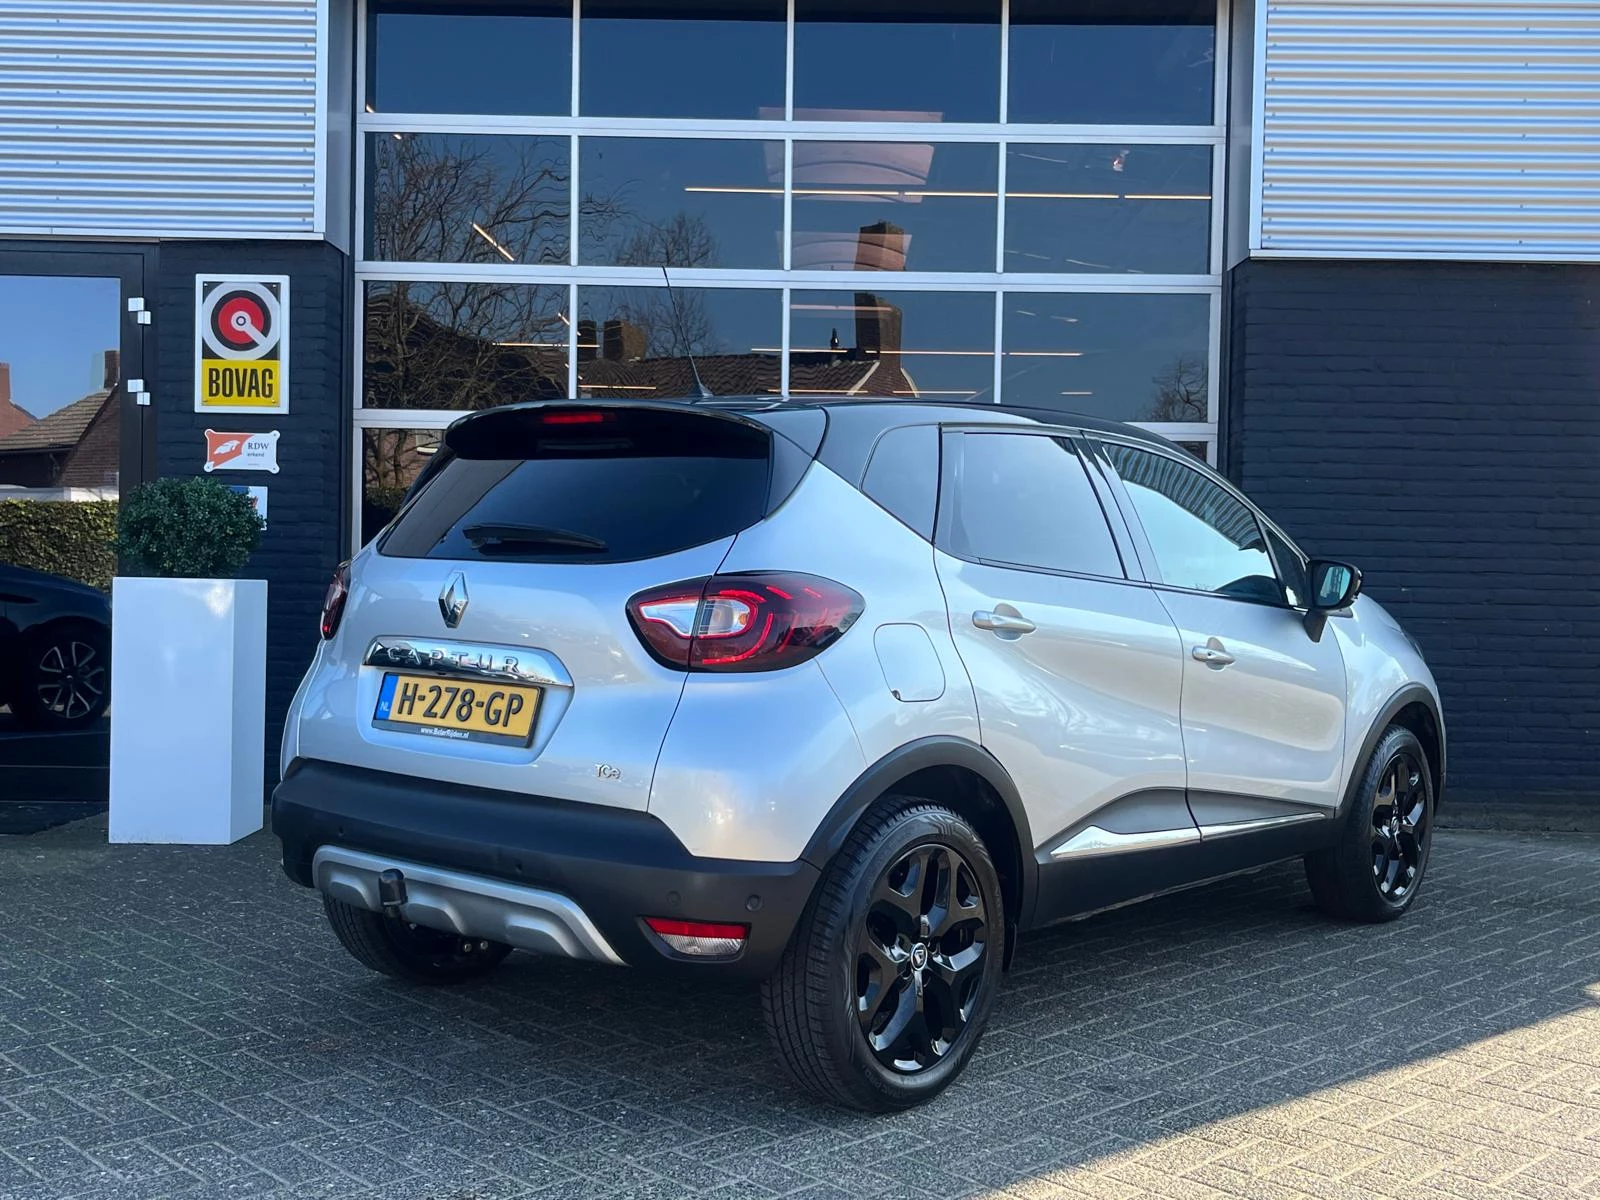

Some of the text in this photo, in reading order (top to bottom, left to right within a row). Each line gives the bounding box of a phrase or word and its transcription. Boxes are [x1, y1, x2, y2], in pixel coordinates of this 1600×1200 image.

[208, 367, 274, 398] BOVAG
[247, 442, 270, 450] RDW
[386, 647, 521, 674] CAPTUR
[379, 701, 389, 712] NL
[397, 682, 524, 727] H-278-GP
[594, 764, 621, 779] TCe
